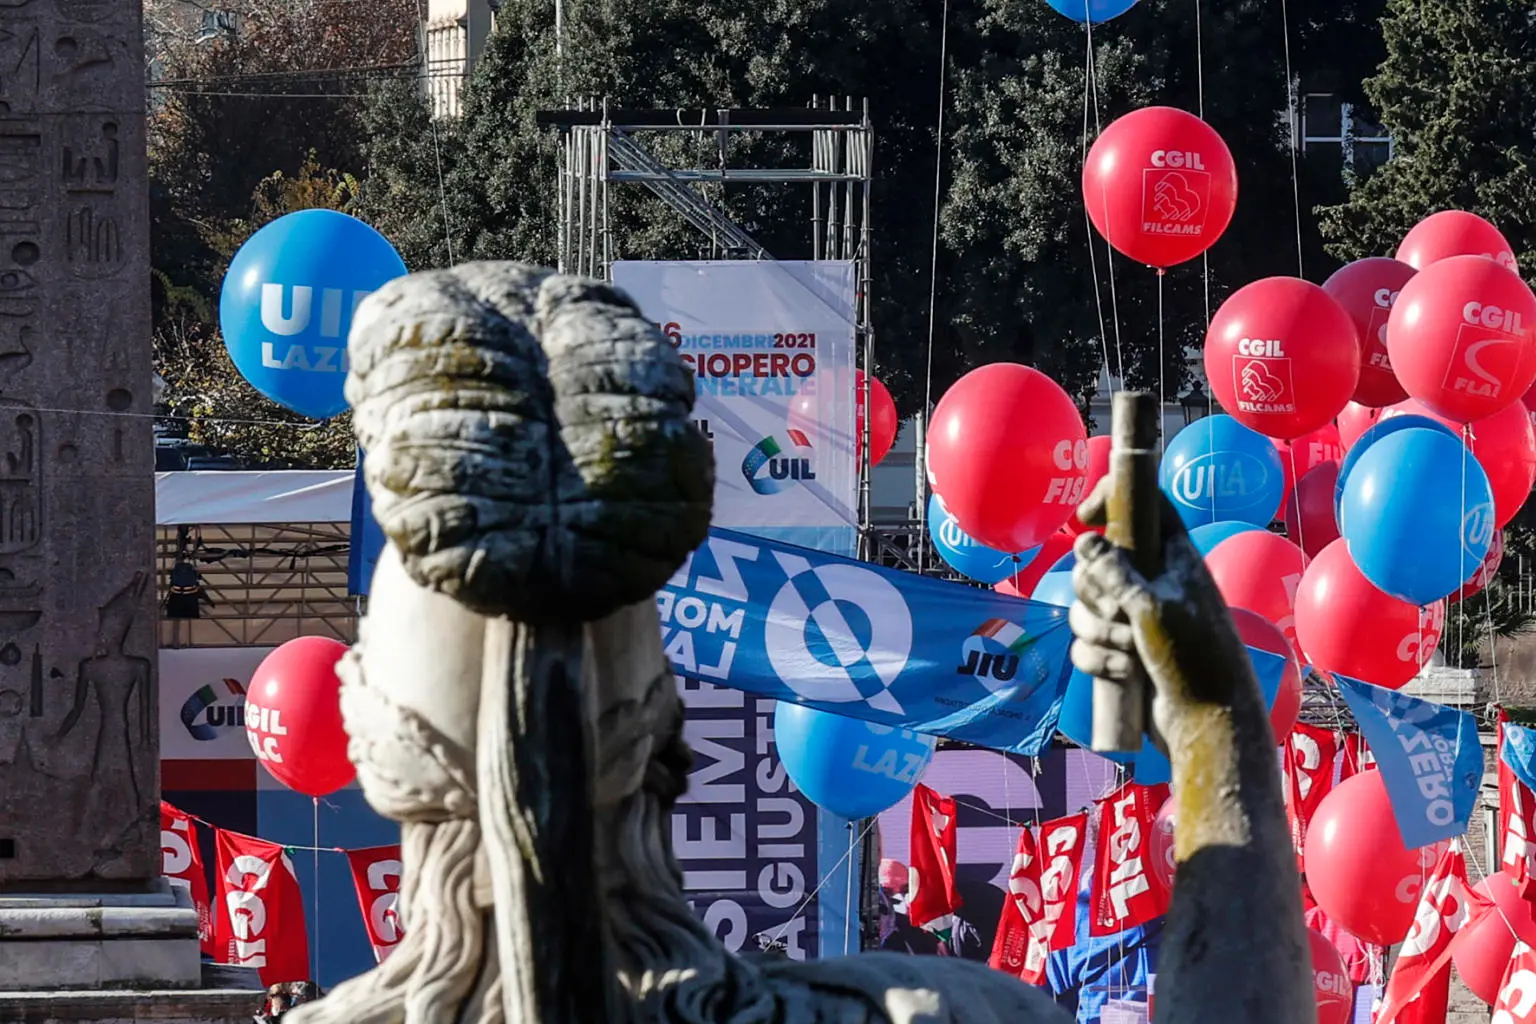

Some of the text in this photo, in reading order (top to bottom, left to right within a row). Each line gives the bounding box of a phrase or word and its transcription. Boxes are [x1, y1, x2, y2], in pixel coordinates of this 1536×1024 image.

[1150, 149, 1205, 171] CGIL
[1142, 221, 1202, 236] FILCAMS
[1463, 302, 1526, 337] CGIL
[774, 333, 816, 349] 2021
[1238, 337, 1285, 358] CGIL
[1454, 377, 1502, 398] FLAI
[1238, 401, 1295, 414] FILCAMS
[769, 458, 815, 480] UIL
[1184, 465, 1248, 500] UILA
[1110, 792, 1150, 920] CGIL
